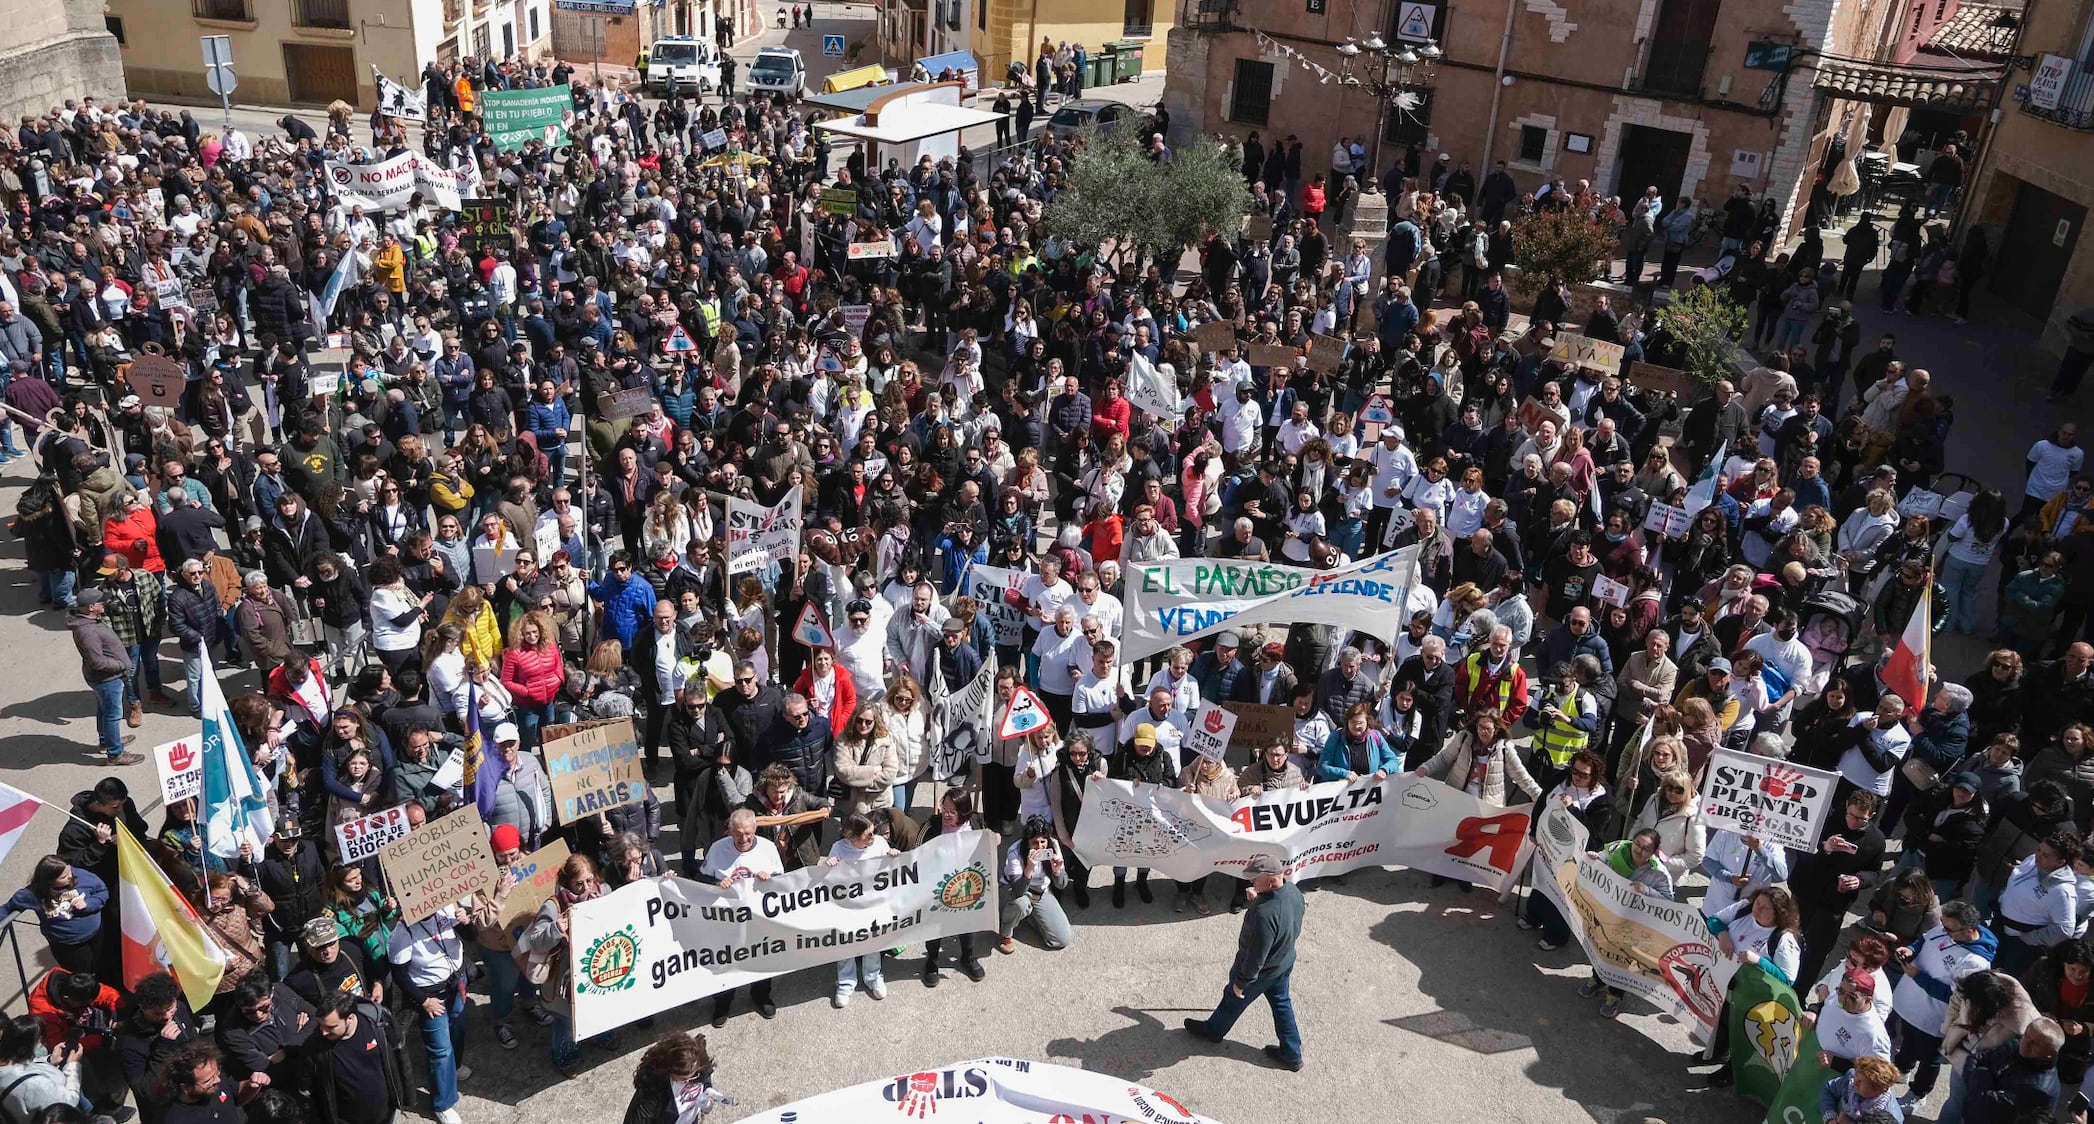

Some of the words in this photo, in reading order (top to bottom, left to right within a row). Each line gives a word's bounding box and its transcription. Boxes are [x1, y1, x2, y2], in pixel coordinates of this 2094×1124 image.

[559, 2, 574, 10] BAR
[594, 5, 630, 14] MELLIZOS
[484, 99, 501, 107] STOP
[501, 97, 540, 107] GANADERÍA
[484, 111, 494, 120] NI
[496, 110, 506, 119] EN
[508, 110, 520, 118] TU
[521, 108, 553, 118] PUEBLO
[485, 123, 495, 132] NI
[497, 122, 508, 130] EN
[360, 172, 382, 184] NO
[338, 189, 354, 197] POR
[1142, 386, 1158, 398] NO
[731, 550, 741, 559] Ni
[742, 548, 754, 556] en
[766, 538, 794, 552] pueblo
[734, 562, 744, 570] ni
[744, 559, 757, 567] en
[1142, 567, 1179, 595] EL
[1194, 563, 1303, 596] PARAÍSO
[1194, 728, 1222, 749] STOP
[166, 768, 202, 791] STOP
[1406, 792, 1431, 803] Cuenca
[1710, 784, 1810, 822] PLANTA
[343, 808, 401, 840] STOP
[1342, 810, 1380, 823] vaciada
[346, 830, 386, 849] PLANTA
[390, 824, 404, 834] DE
[388, 814, 469, 861] REPOBLAR
[1335, 839, 1356, 850] ser
[422, 840, 450, 862] CON
[1294, 857, 1306, 874] DE
[1309, 843, 1380, 865] SACRIFICIO!
[400, 842, 480, 890] HUMANOS
[421, 877, 444, 896] NO
[450, 860, 477, 880] CON
[410, 870, 489, 918] MARRANOS
[646, 896, 691, 928] Por
[701, 905, 753, 923] una
[762, 882, 864, 918] Cuenca
[873, 861, 920, 892] SIN
[592, 938, 616, 969] PUEBLOS
[619, 938, 632, 957] VIVOS
[651, 938, 786, 990] ganadería
[796, 908, 922, 950] industrial
[1664, 946, 1684, 962] STOP
[1132, 1096, 1156, 1118] dicen
